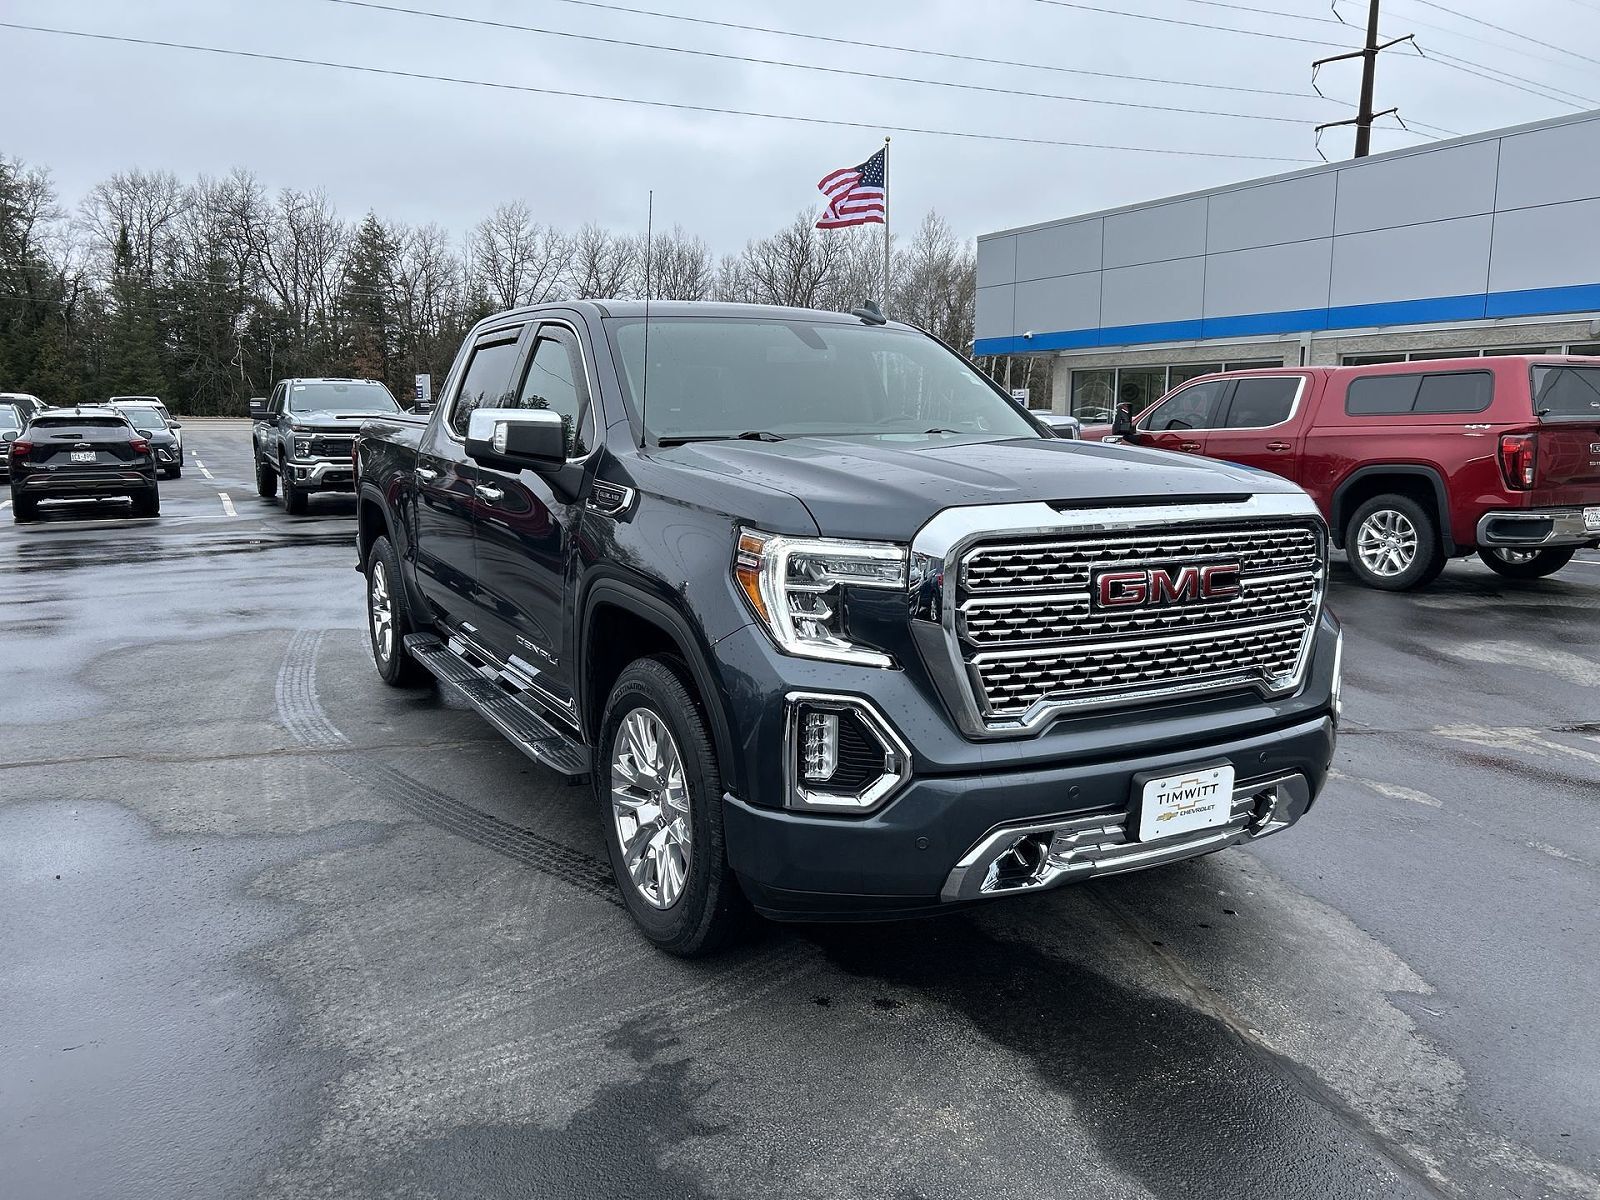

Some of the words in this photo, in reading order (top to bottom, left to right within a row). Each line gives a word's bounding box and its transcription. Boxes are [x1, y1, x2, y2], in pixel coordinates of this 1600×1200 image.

[1096, 563, 1241, 609] GMC
[1157, 783, 1219, 805] TIMWITT
[1179, 804, 1216, 816] CHEVROLET
